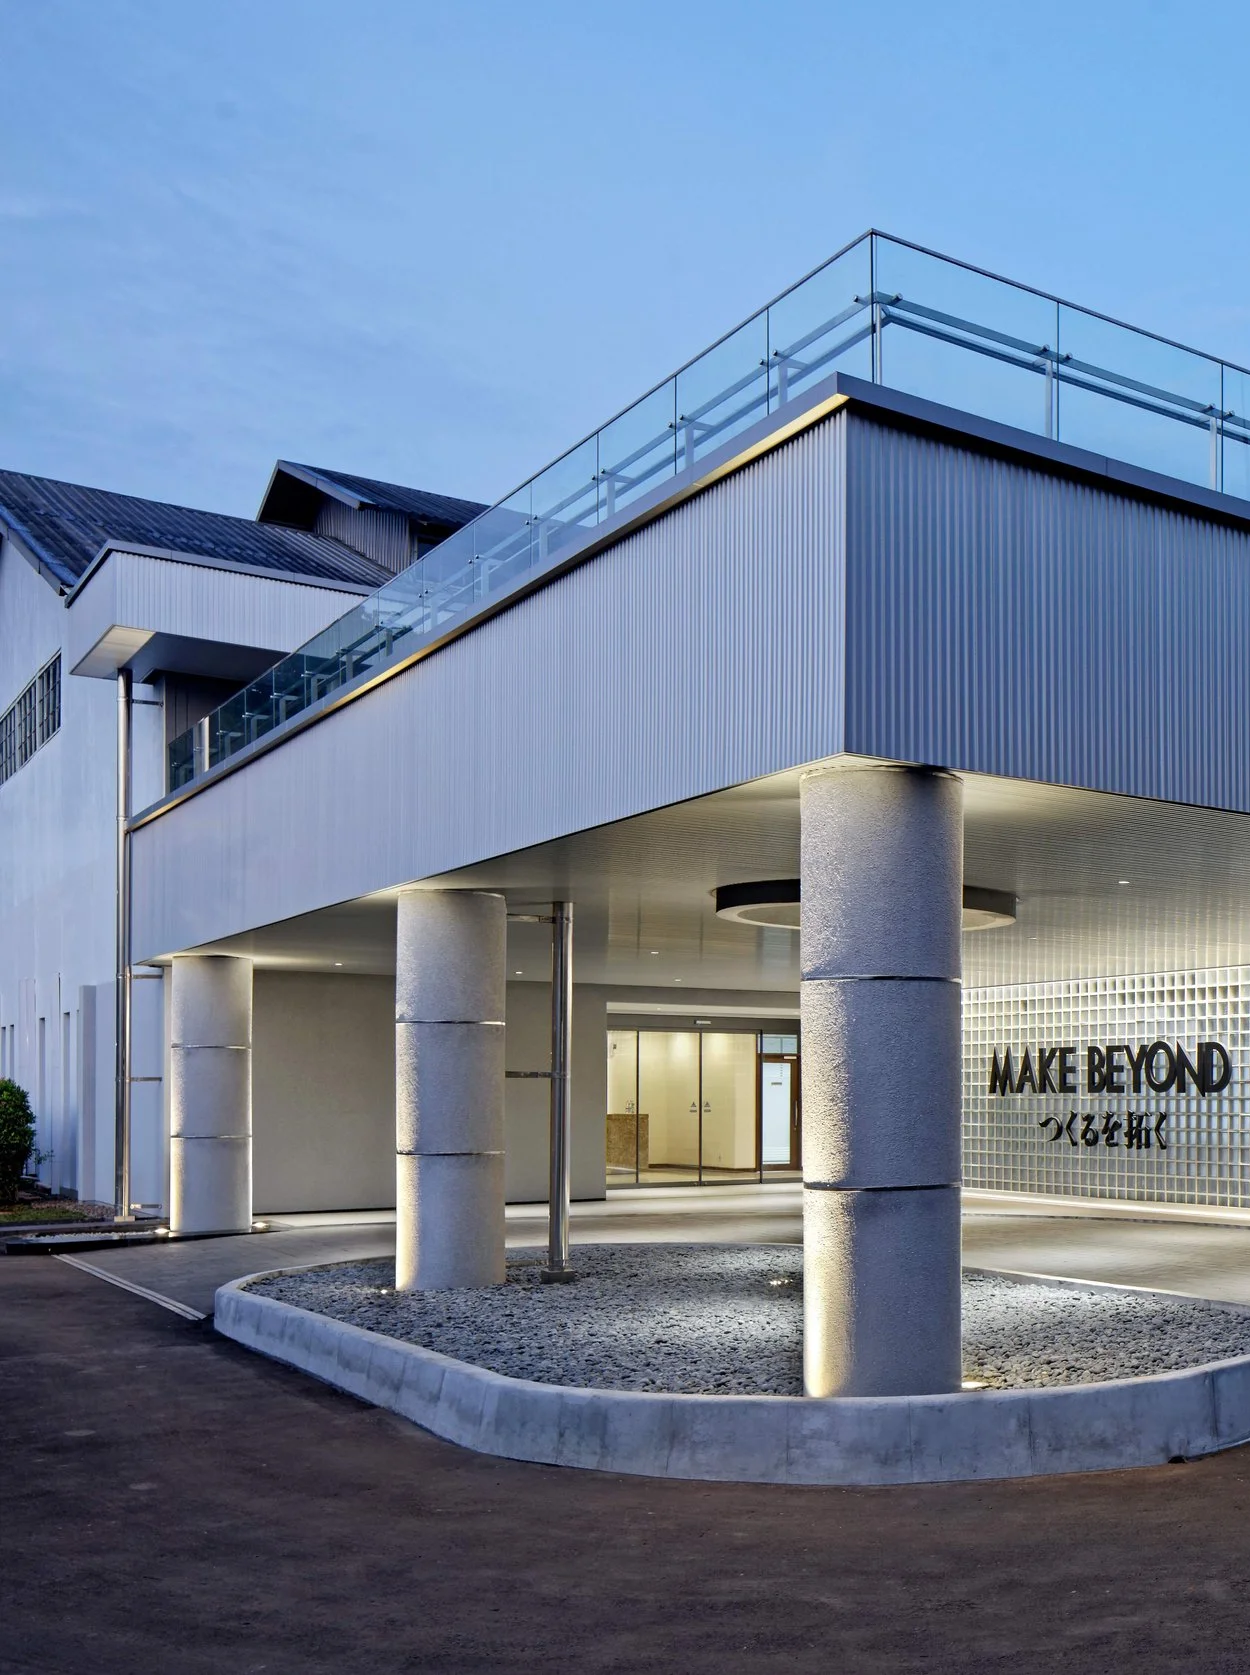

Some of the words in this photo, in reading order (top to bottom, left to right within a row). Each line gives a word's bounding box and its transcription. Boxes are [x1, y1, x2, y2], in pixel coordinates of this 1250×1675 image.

[989, 1045, 1077, 1097] MAKE
[1088, 1040, 1233, 1097] BEYOND
[1039, 1110, 1167, 1150] つくるを拓く
